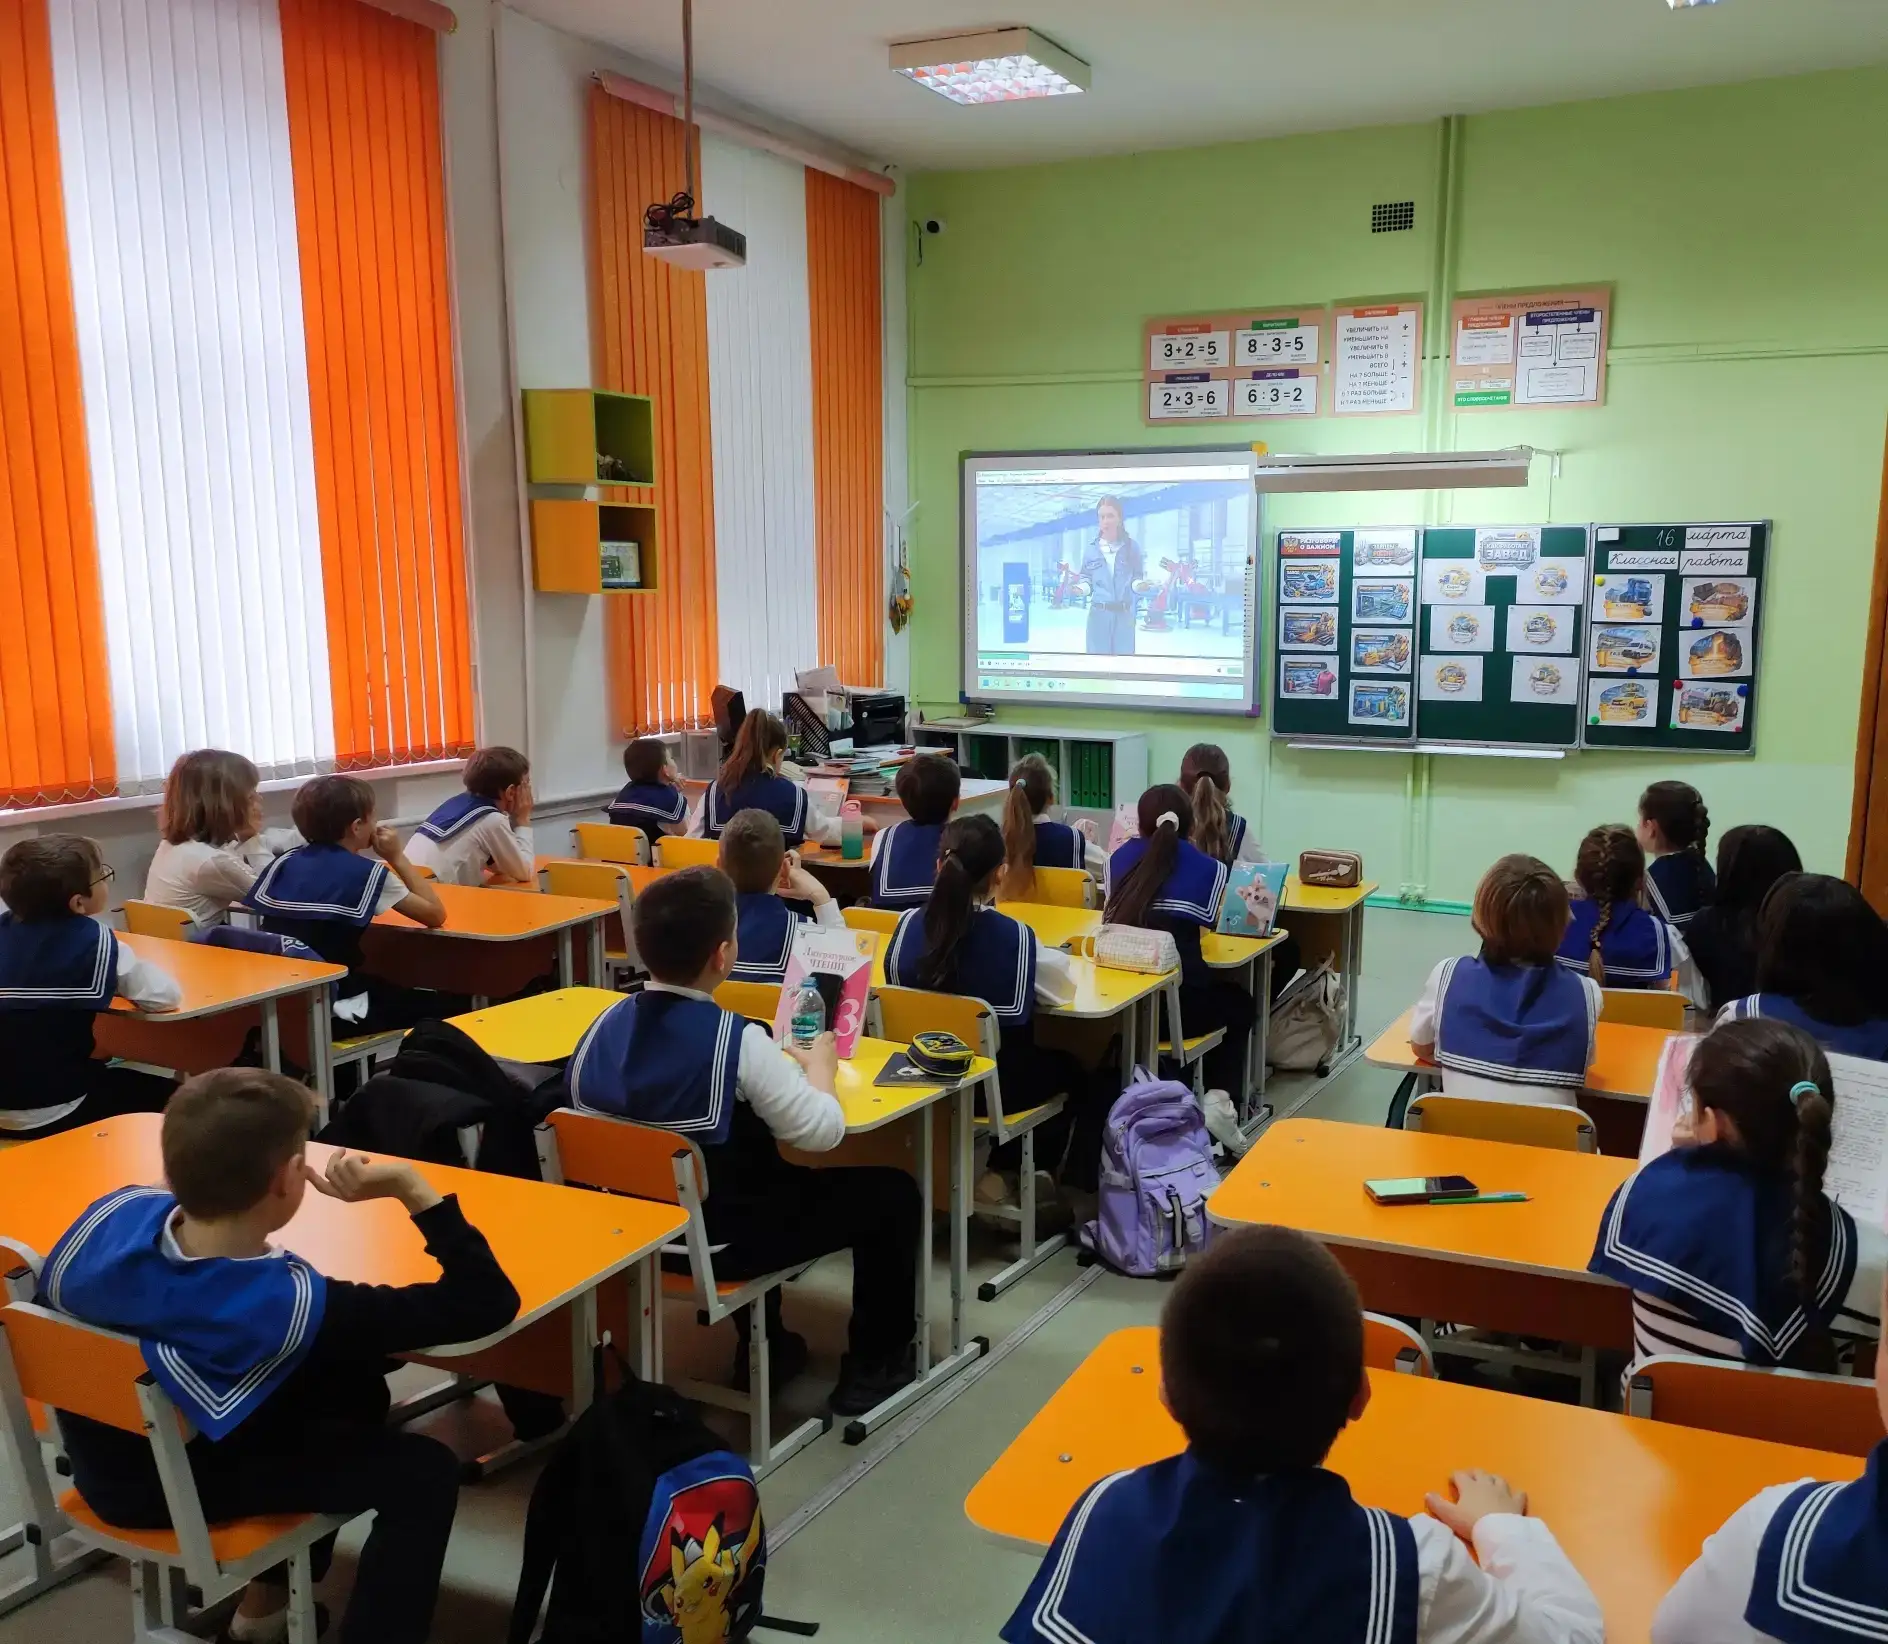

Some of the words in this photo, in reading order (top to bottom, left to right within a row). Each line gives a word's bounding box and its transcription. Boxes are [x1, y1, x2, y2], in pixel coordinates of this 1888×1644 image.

[1518, 300, 1563, 308] ПРЕДЛОЖЕНИЯ
[1656, 529, 1676, 547] 16
[1486, 550, 1528, 560] ЗАВОД
[1610, 553, 1677, 565] Классная
[803, 947, 857, 962] Литературное
[833, 998, 860, 1037] 3
